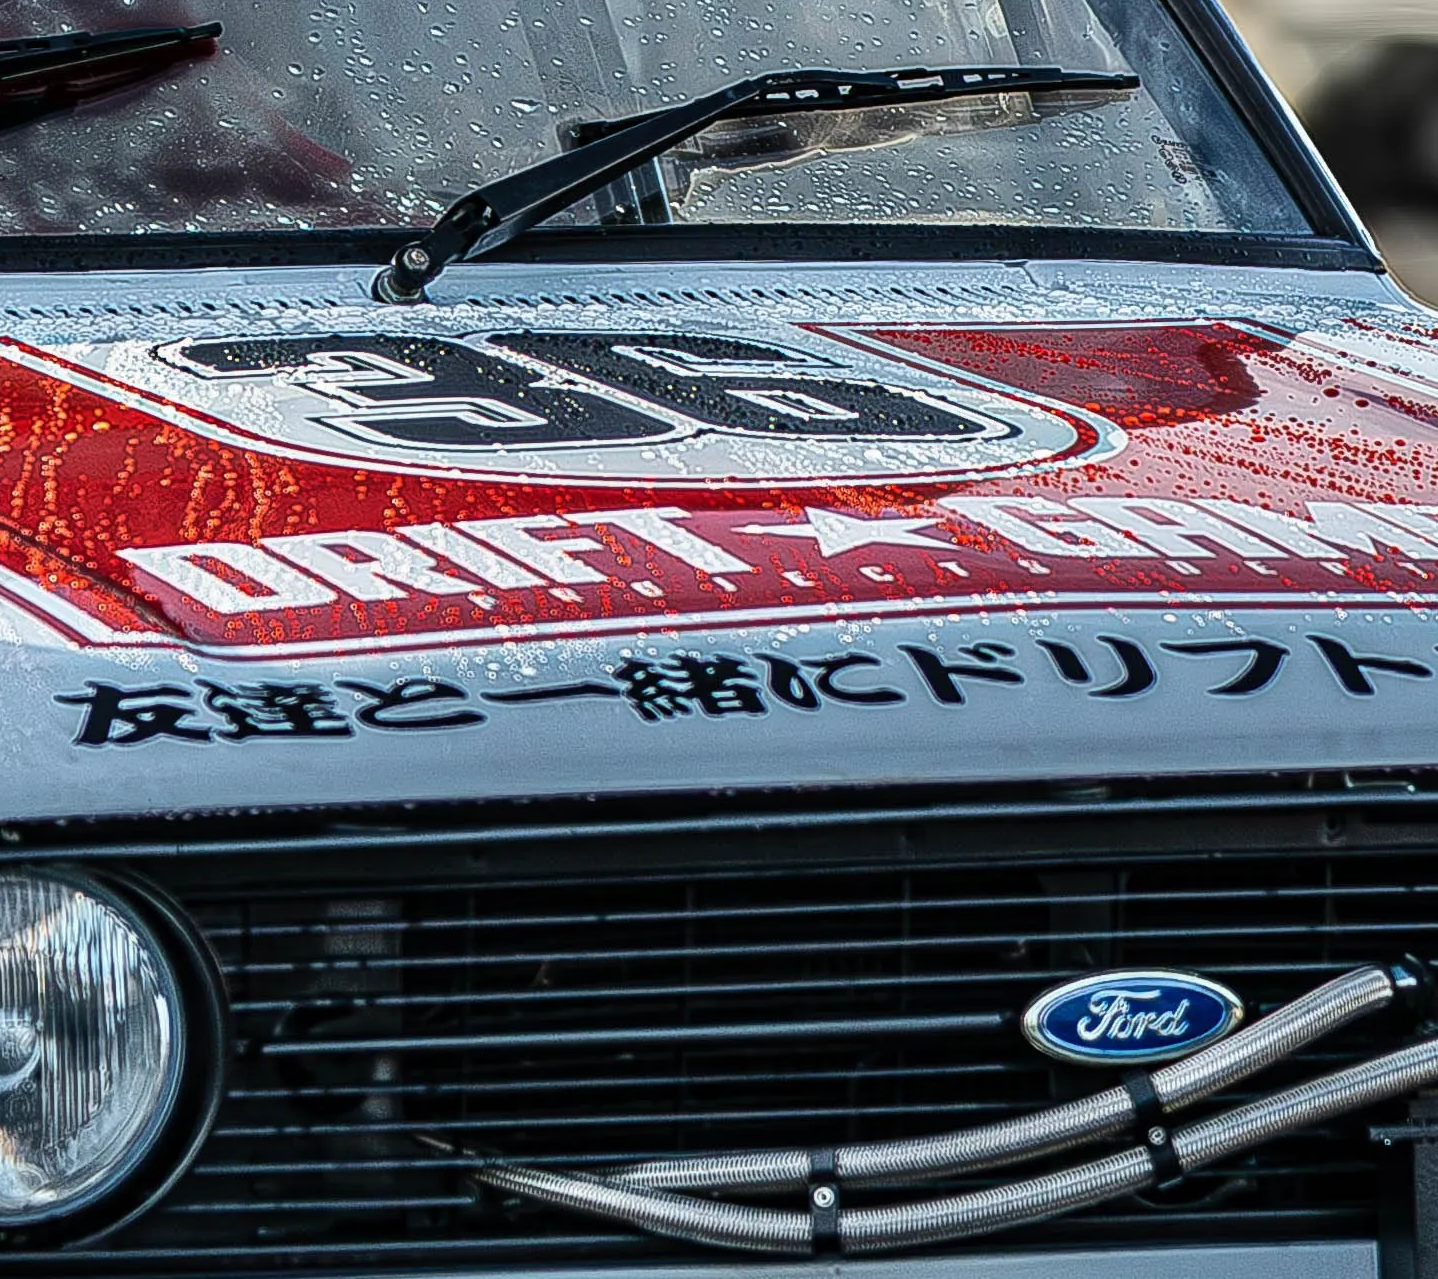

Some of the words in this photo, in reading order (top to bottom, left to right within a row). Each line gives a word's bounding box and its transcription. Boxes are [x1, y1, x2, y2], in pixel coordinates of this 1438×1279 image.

[153, 330, 1020, 452] 36
[114, 506, 754, 615] DRIFT
[1077, 989, 1190, 1041] Ford
